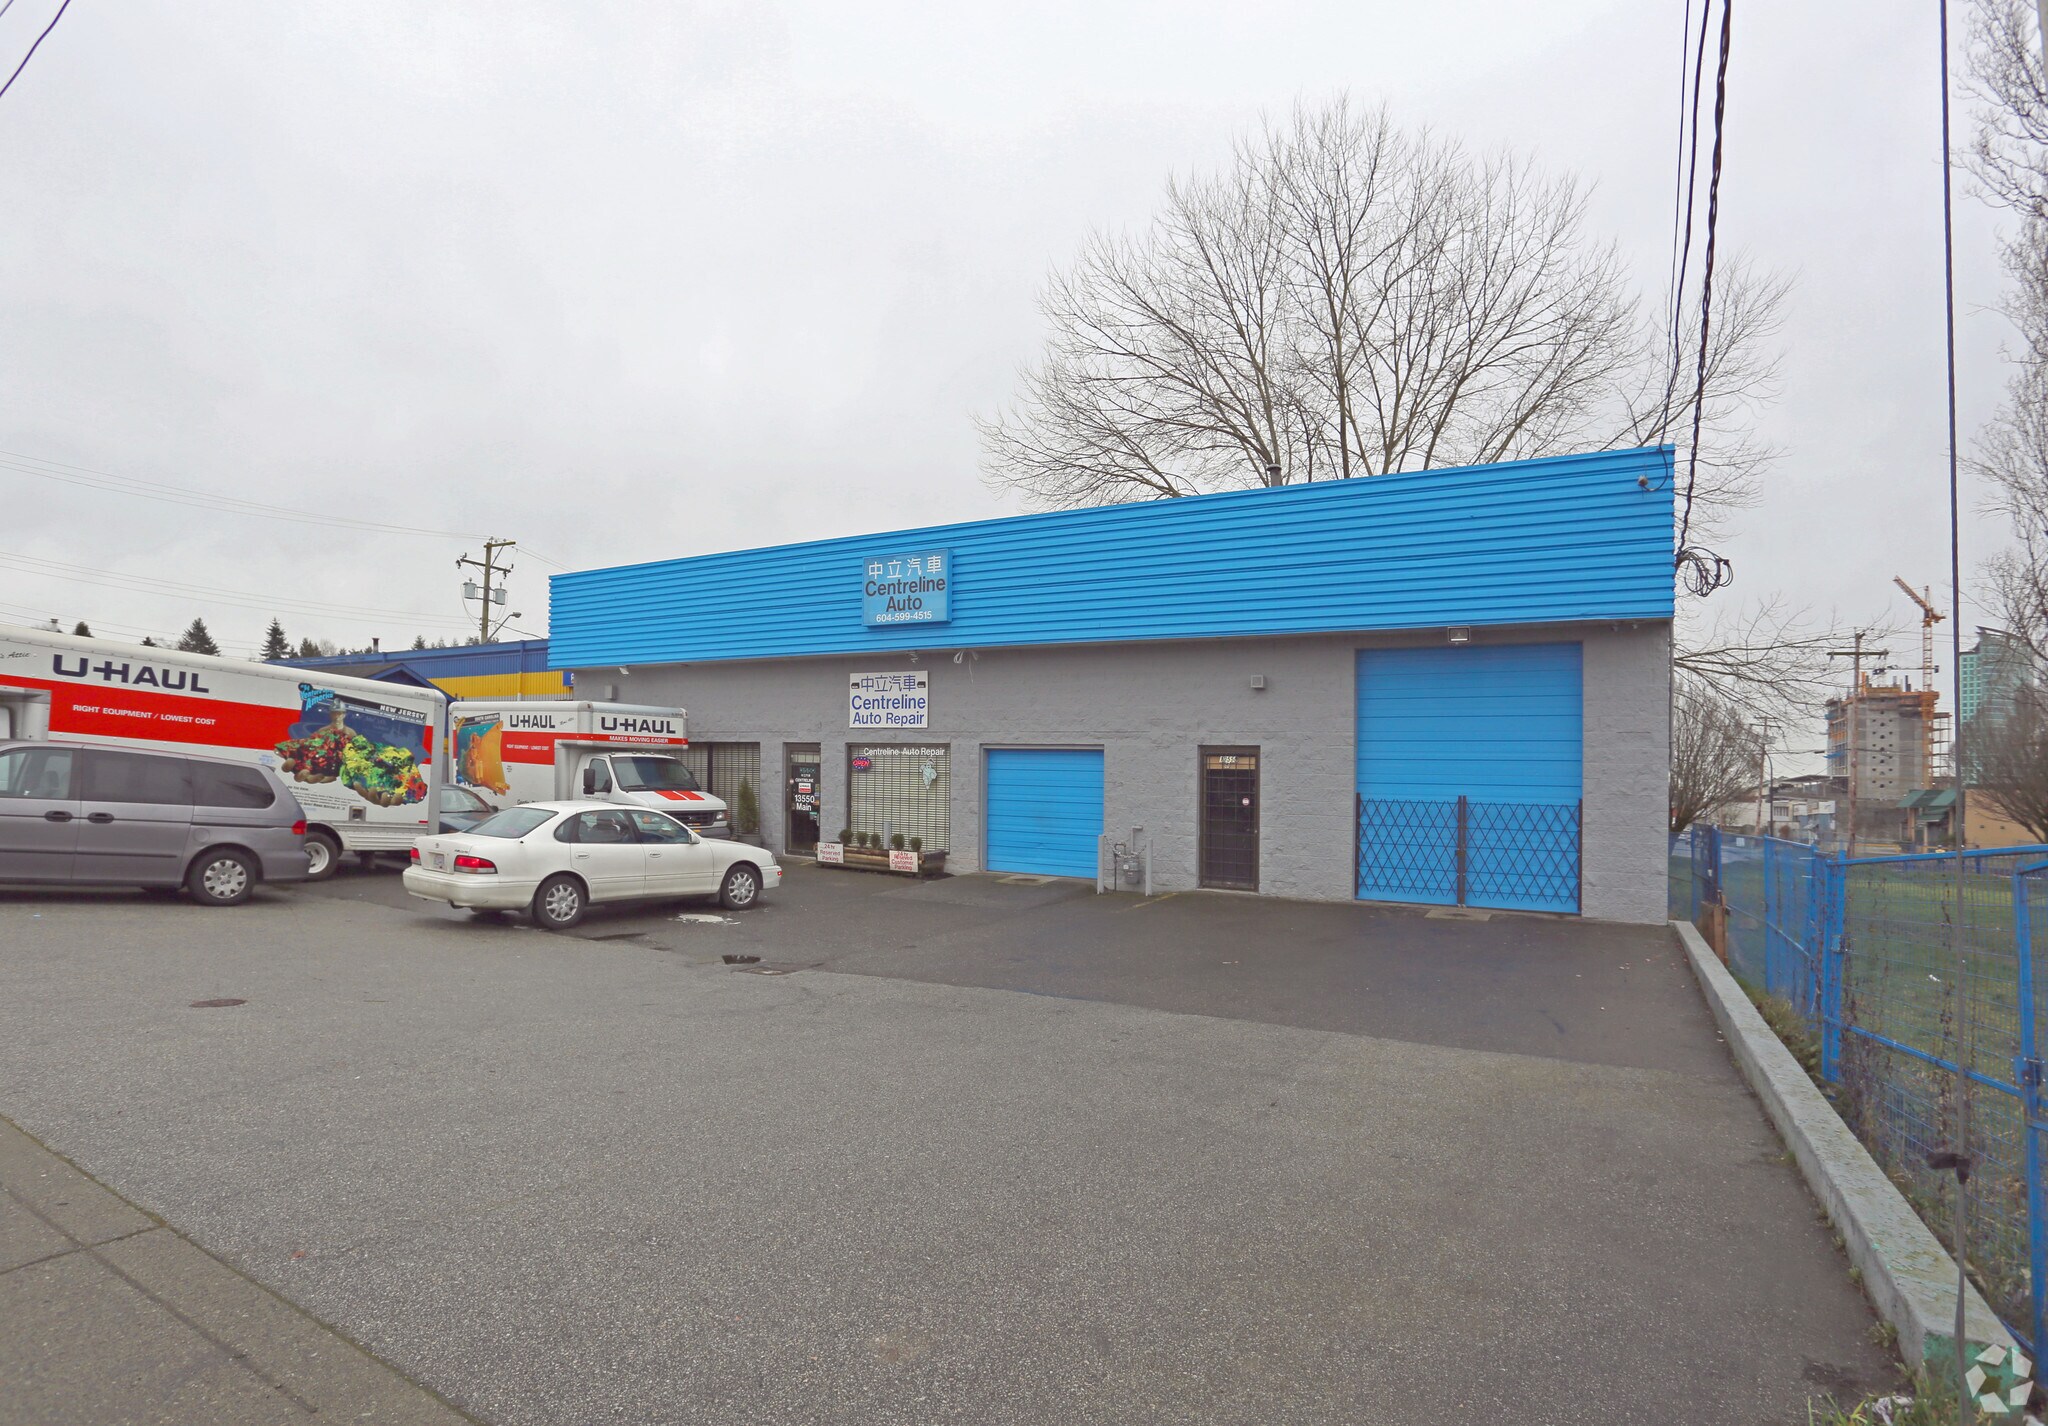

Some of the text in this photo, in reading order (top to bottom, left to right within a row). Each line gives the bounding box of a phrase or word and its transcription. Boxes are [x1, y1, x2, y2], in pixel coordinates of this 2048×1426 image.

[868, 555, 942, 579] 中立汽車
[865, 576, 946, 597] Centreline
[886, 594, 923, 612] Auto
[876, 610, 932, 622] 604-599-4515
[53, 654, 209, 694] U-HAUL
[861, 674, 917, 692] 中立汽車
[851, 694, 926, 710] Centreline
[72, 704, 100, 713] RIGHT
[103, 707, 152, 719] EQUIPMENT
[160, 714, 193, 723] LOWEST
[195, 717, 216, 726] COST
[380, 704, 396, 713] NEW
[397, 708, 425, 719] JERSEY
[852, 711, 925, 727] Auto Repair
[510, 715, 555, 728] U-HAUL
[601, 716, 676, 734] U-HAUL
[863, 747, 945, 757] Centreline Auto Repair
[794, 795, 815, 803] 13550
[796, 803, 812, 811] Main
